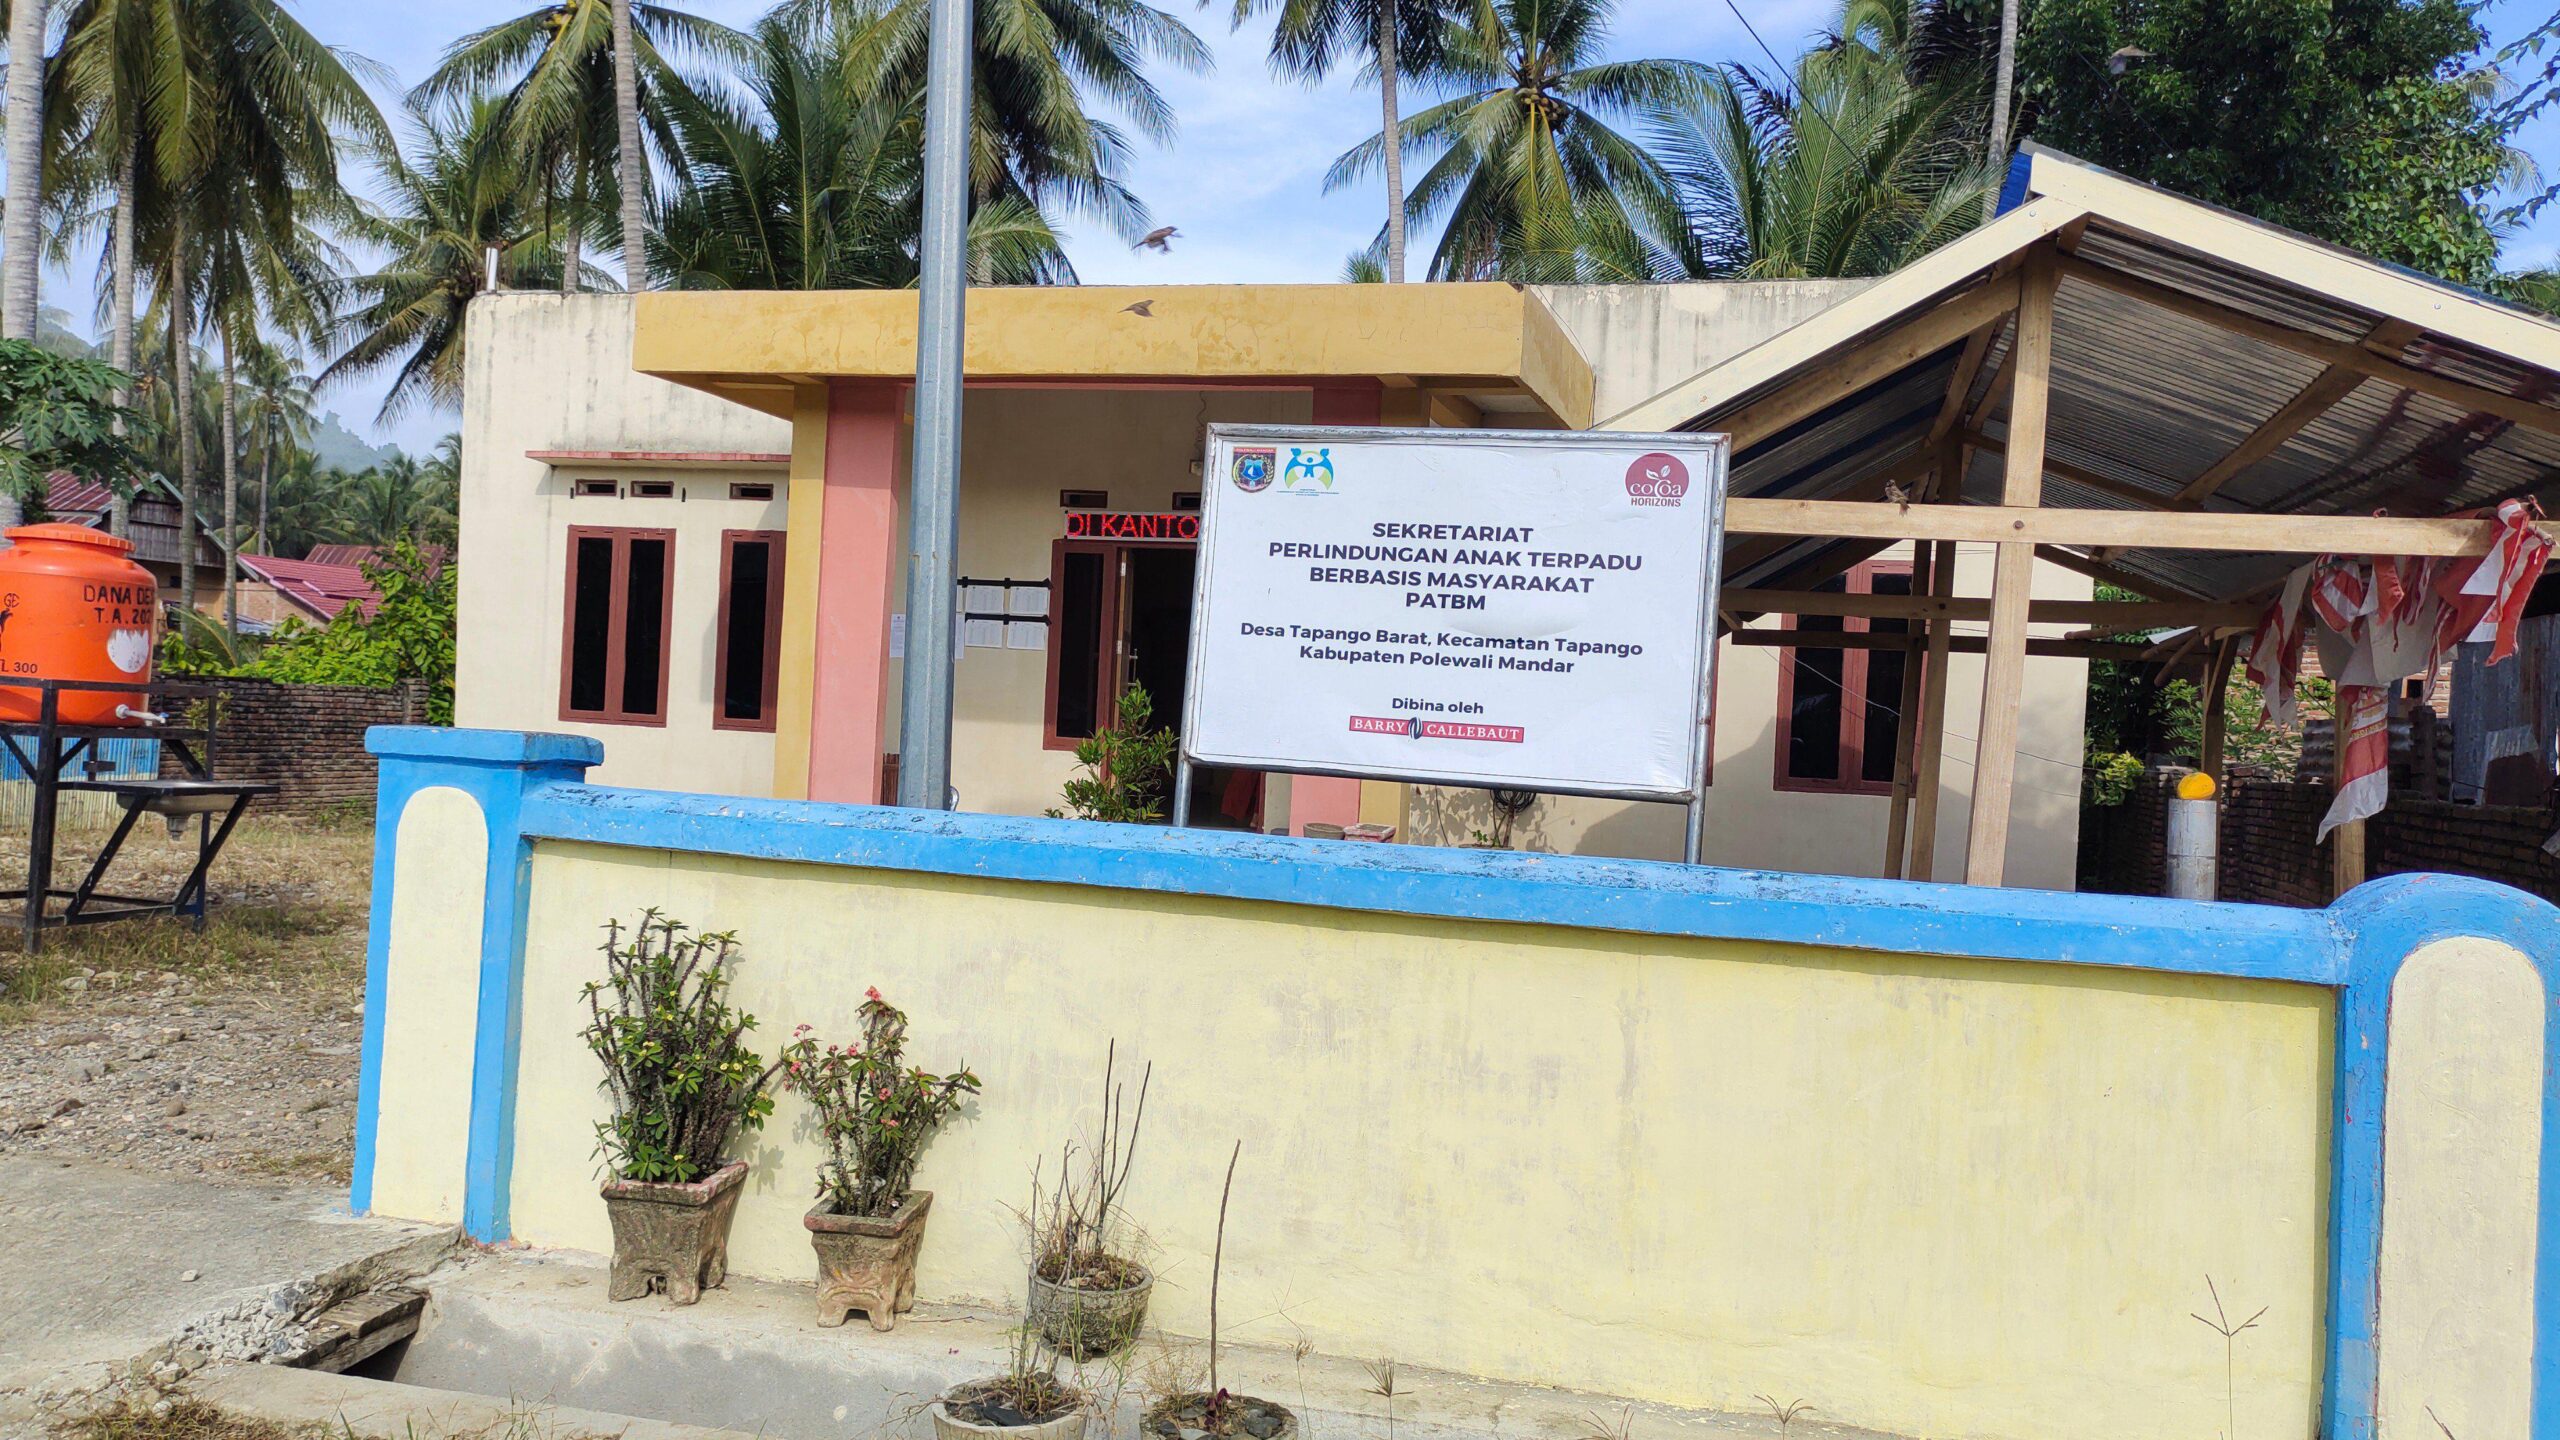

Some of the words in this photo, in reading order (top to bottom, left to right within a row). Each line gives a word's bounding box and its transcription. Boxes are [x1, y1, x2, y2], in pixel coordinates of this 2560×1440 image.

[1631, 497, 1682, 507] HORIZONS
[1067, 513, 1091, 537] DI
[1372, 522, 1534, 543] SEKRETARIAT
[1269, 542, 1448, 564] PERLINDUNGAN
[1453, 548, 1522, 567] ANAK
[1528, 551, 1642, 571] TERPADU
[1309, 566, 1422, 587] BERBASIS
[1427, 572, 1595, 594] MASYARAKAT
[83, 584, 132, 605] DANA
[1405, 592, 1486, 611] PATBM
[1240, 622, 1286, 638] Desa
[1290, 625, 1372, 645] Tapango
[1376, 629, 1432, 647] Barat,
[1437, 632, 1550, 651] Kecamatan
[1555, 638, 1643, 659] Tapango
[14, 661, 38, 674] 300
[1299, 645, 1405, 665] Kabupaten
[1409, 651, 1494, 670] Polewali
[1498, 655, 1575, 673] Mandar
[1391, 697, 1444, 712] Dibina
[1448, 701, 1484, 714] oleh
[1353, 718, 1406, 733] BARRY
[1426, 723, 1520, 740] CALLEBAUT
